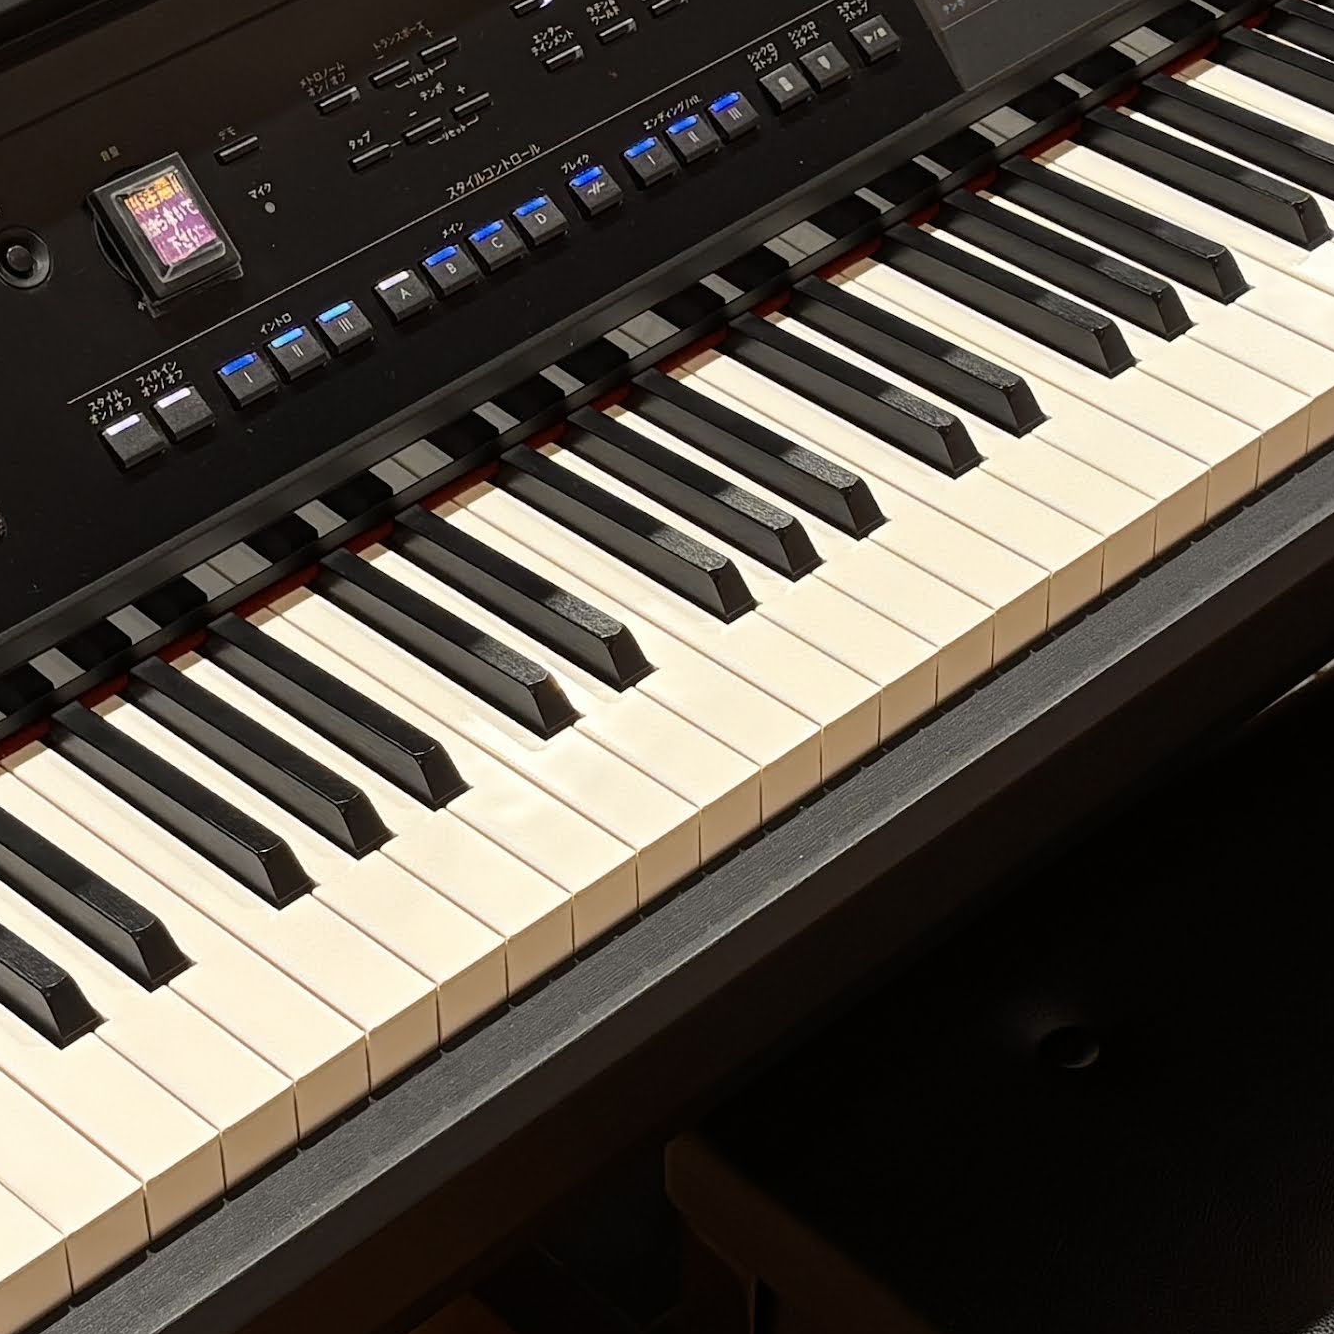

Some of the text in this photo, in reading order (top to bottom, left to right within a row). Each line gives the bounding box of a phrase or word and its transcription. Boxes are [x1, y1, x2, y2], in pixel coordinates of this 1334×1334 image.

[373, 20, 425, 51] トランスポーズ
[300, 61, 345, 88] メトロノーム
[419, 81, 444, 101] テンポ
[349, 130, 371, 150] タップ
[445, 143, 542, 200] スタイルコントロール
[560, 153, 591, 175] ブレイク
[247, 182, 272, 200] マイク
[536, 212, 547, 225] D
[441, 222, 464, 239] メイン
[491, 236, 504, 250] C
[446, 262, 457, 275] B
[399, 287, 413, 300] A
[260, 313, 292, 335] イントロ
[136, 360, 178, 387] フィルイン
[141, 369, 184, 399] オン/オフ
[88, 388, 124, 412] スタイル
[89, 397, 132, 425] オン/オフ
